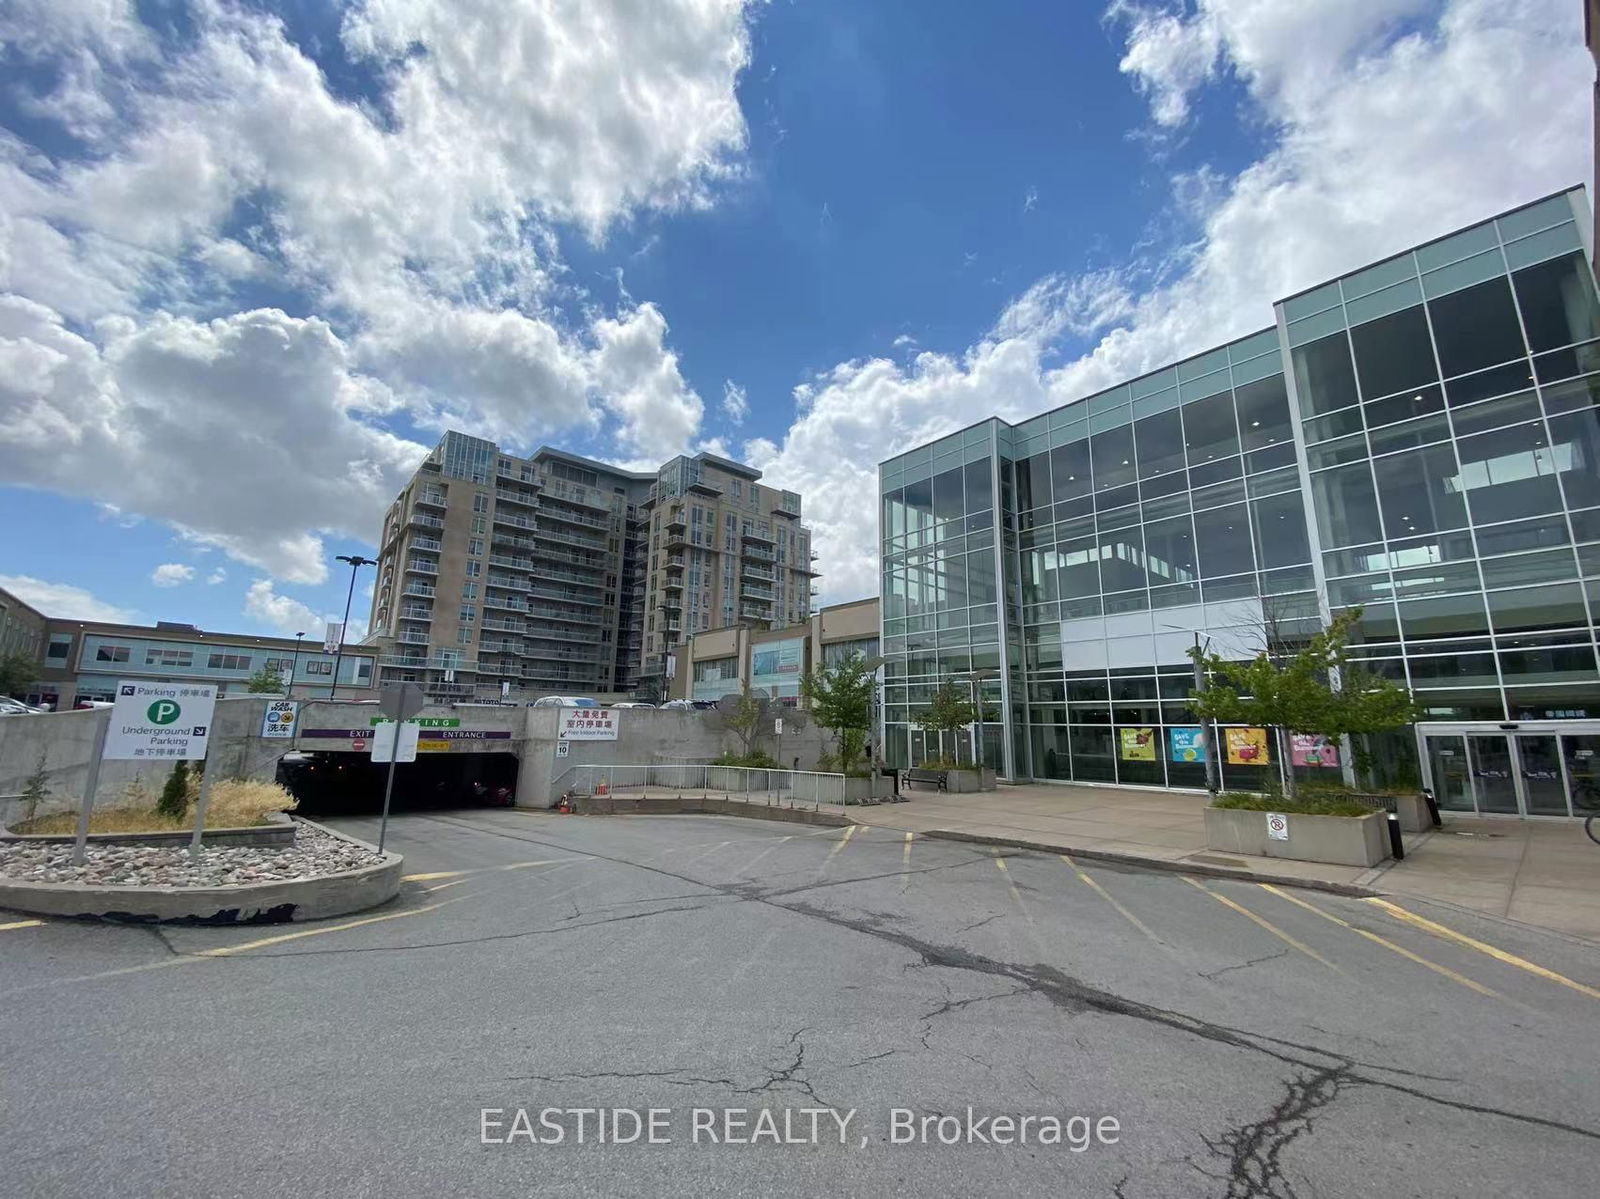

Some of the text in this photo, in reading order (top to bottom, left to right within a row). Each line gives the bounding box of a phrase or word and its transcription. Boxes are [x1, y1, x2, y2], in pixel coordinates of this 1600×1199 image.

[137, 687, 176, 697] Parking
[157, 703, 175, 721] P
[122, 726, 191, 736] Underground
[350, 730, 371, 738] EXIT
[150, 737, 188, 746] Parking
